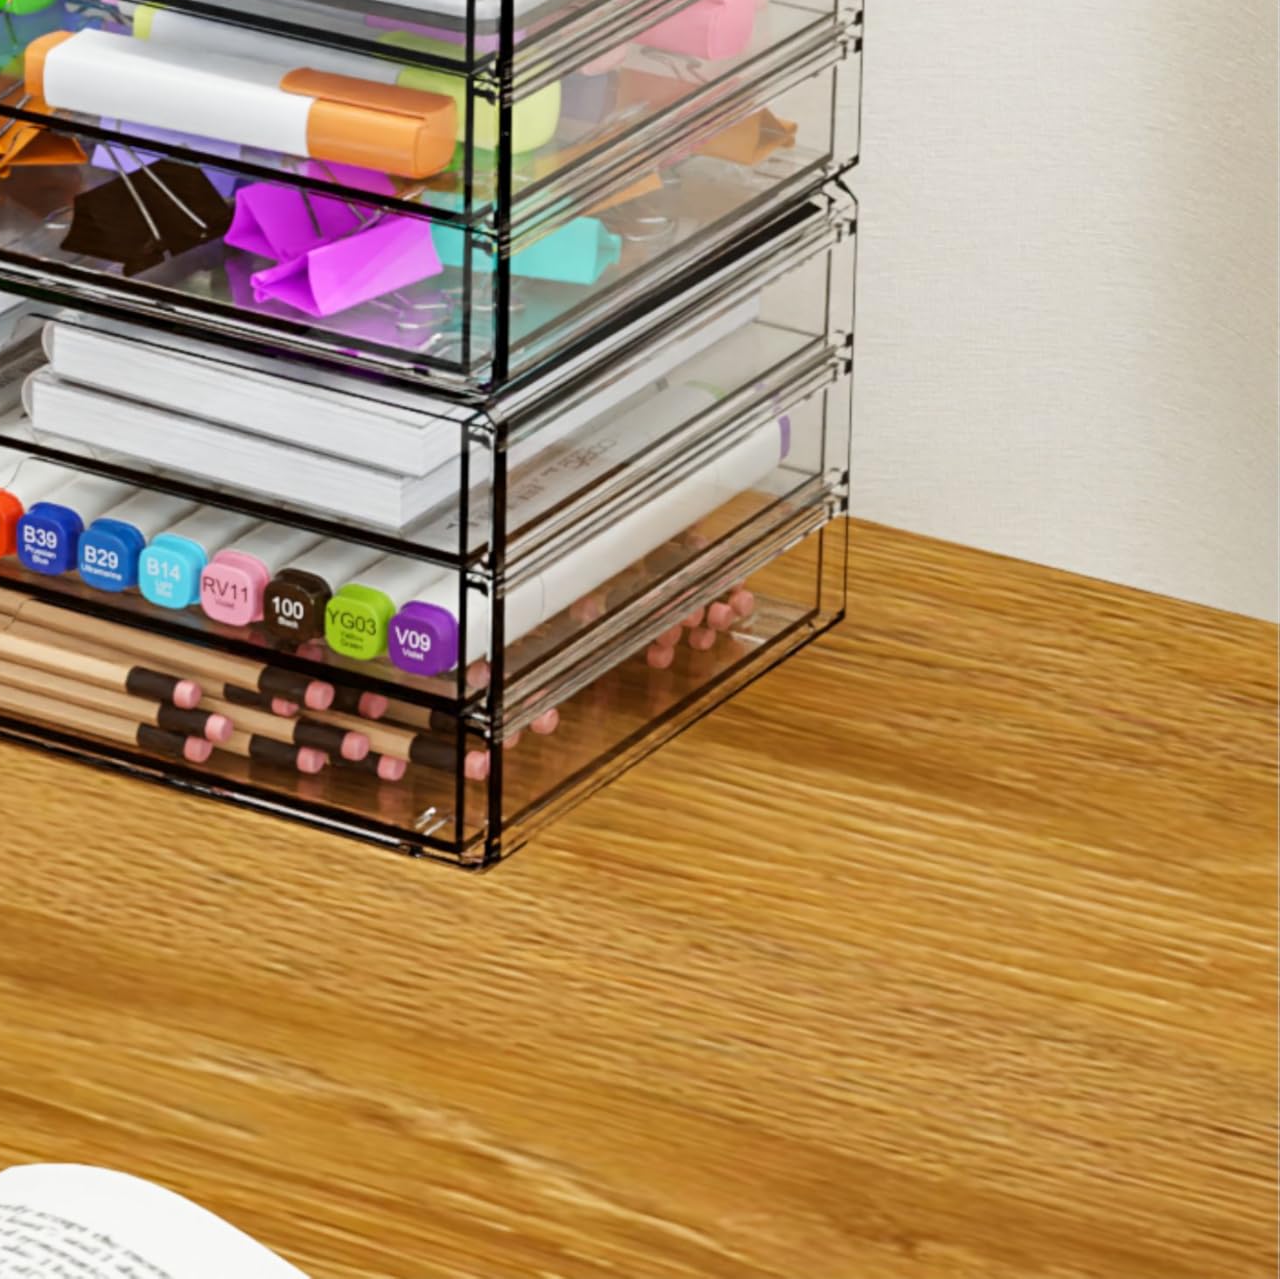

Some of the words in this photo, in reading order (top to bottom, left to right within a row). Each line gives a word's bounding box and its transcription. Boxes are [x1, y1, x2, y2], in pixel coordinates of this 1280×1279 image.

[23, 525, 57, 548] B39
[84, 545, 119, 569] B29
[146, 557, 181, 580] B14
[202, 576, 248, 602] RV11
[272, 596, 304, 619] 100
[327, 607, 376, 636] YG03
[395, 625, 432, 652] V09
